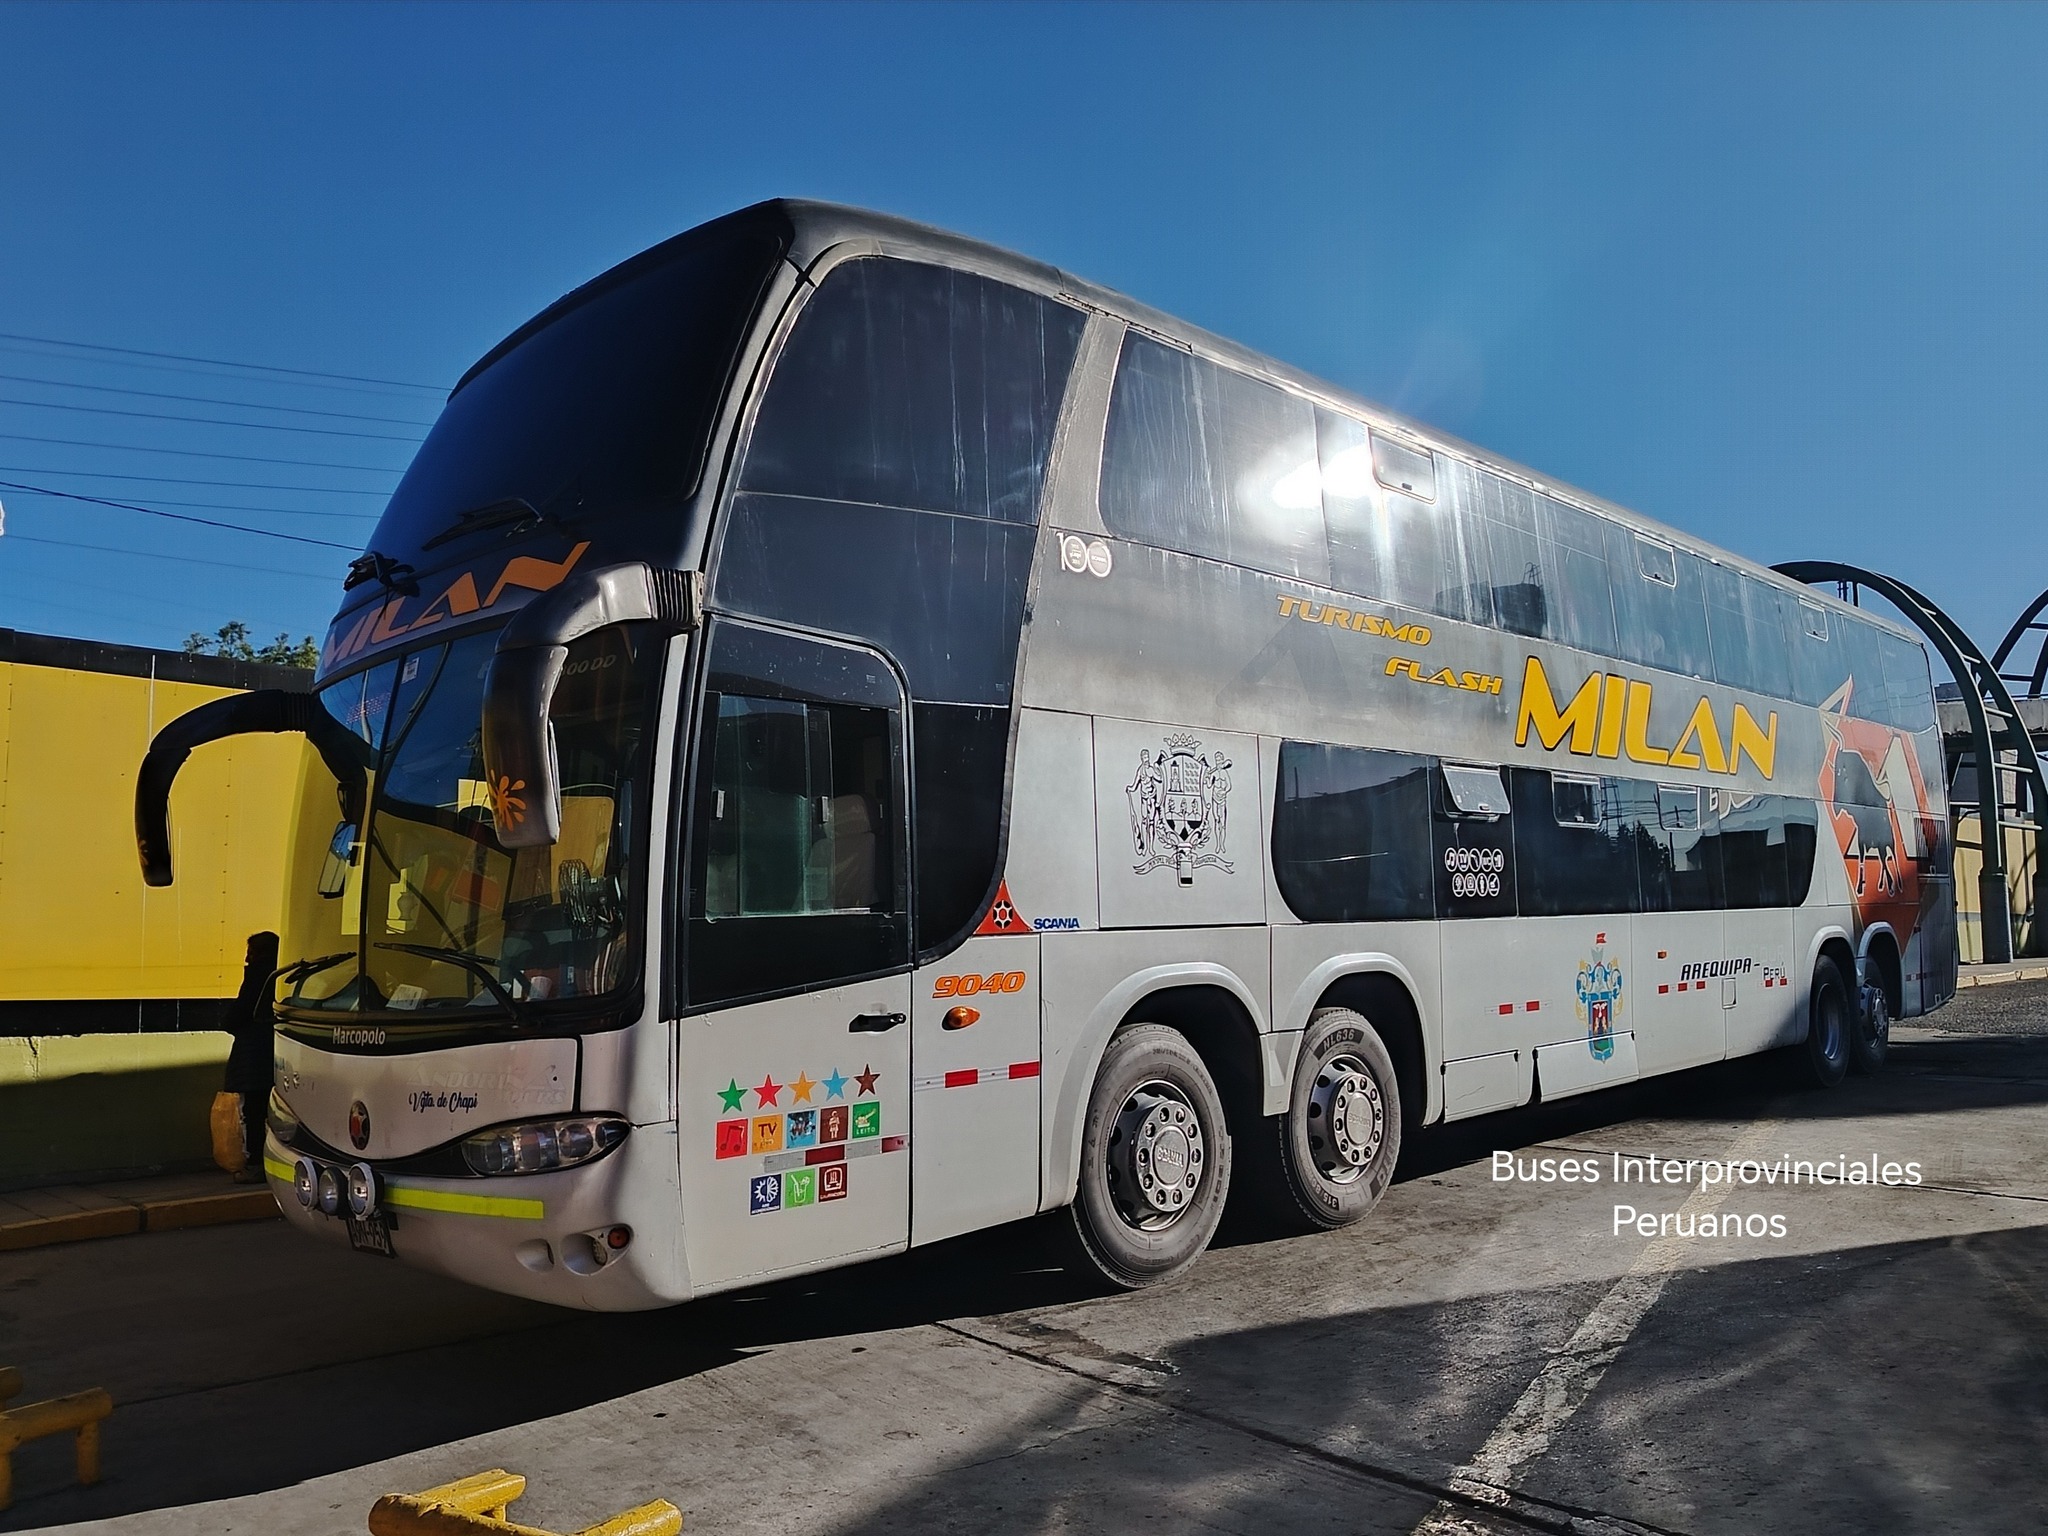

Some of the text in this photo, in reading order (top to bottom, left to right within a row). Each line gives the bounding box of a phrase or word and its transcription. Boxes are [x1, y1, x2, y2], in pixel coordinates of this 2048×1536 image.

[1055, 532, 1112, 578] 100
[323, 541, 591, 669] MILAN
[1277, 594, 1433, 647] TURISMO
[1384, 656, 1503, 695] FLASH
[1515, 655, 1778, 780] MILAN
[1033, 917, 1080, 930] SCANIA
[1680, 958, 1752, 981] AREQUIPA
[932, 971, 1026, 999] 9040
[332, 1026, 386, 1046] Marcopolo
[1323, 1028, 1355, 1052] NL636
[449, 1092, 478, 1114] Chapi
[758, 1122, 777, 1138] TV
[856, 1126, 876, 1134] LEITO
